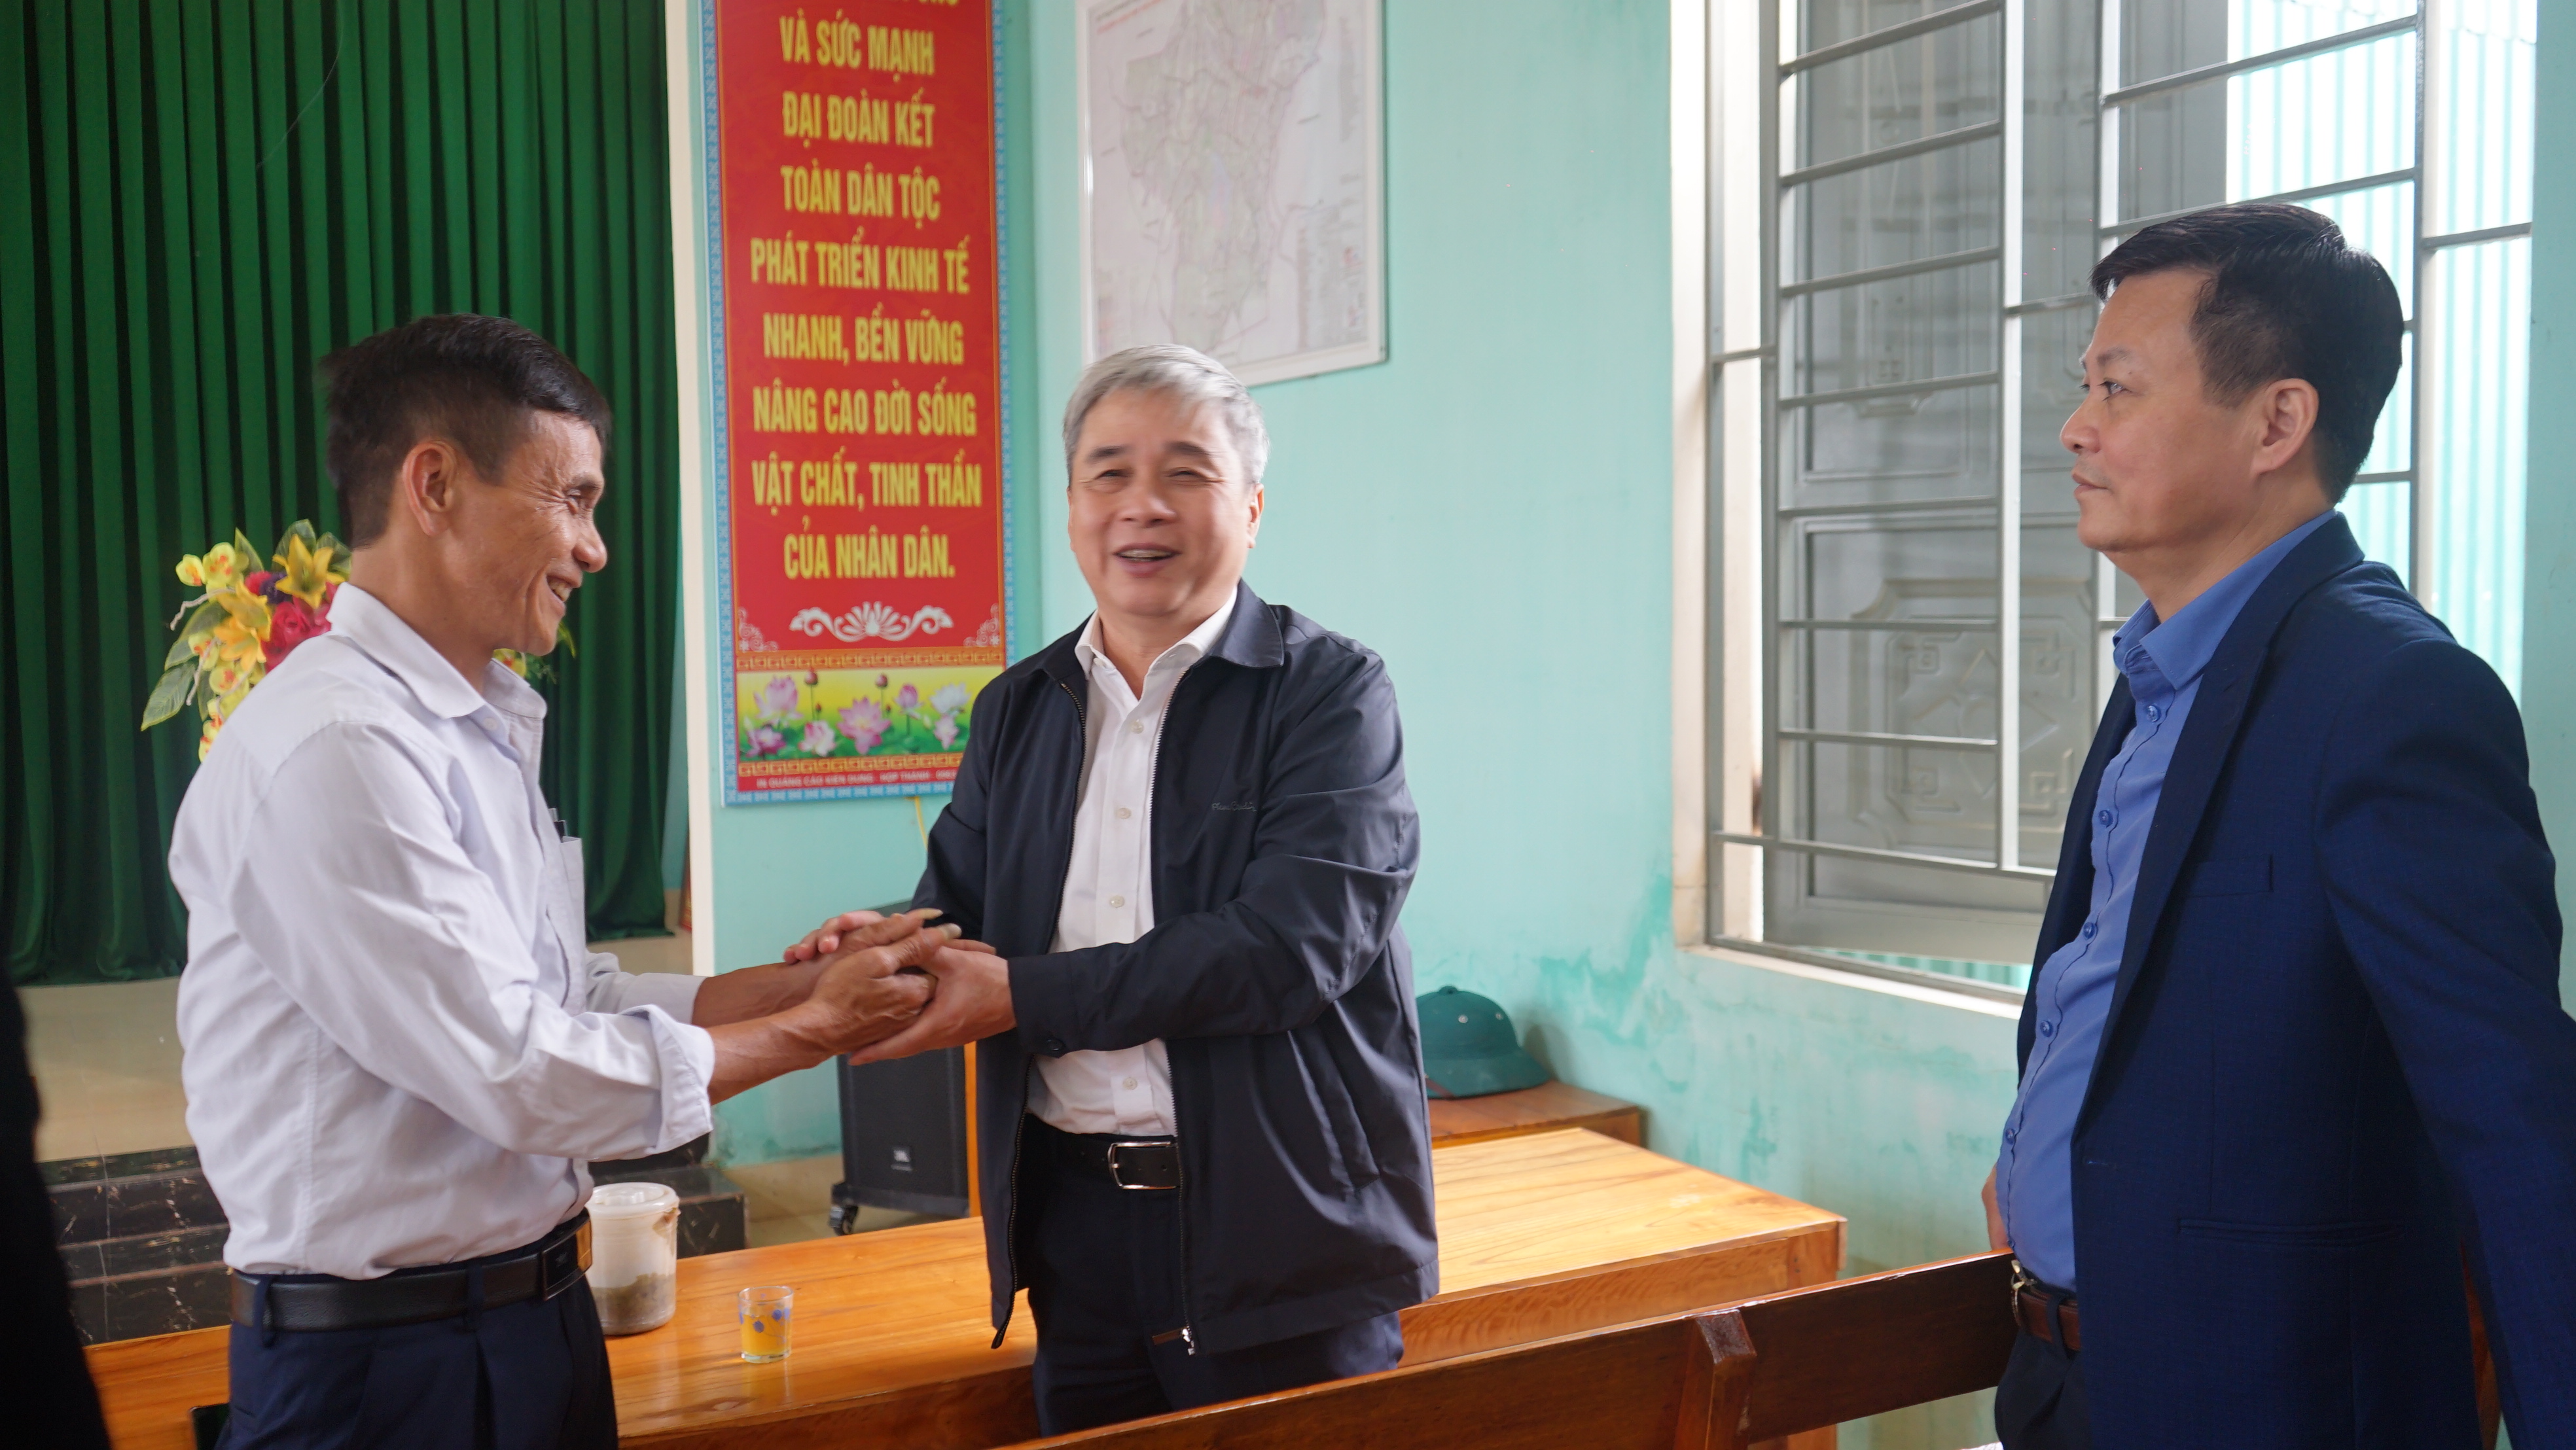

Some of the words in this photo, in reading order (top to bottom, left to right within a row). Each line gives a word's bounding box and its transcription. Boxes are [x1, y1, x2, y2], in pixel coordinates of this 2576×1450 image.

[779, 9, 810, 63] VÀ
[817, 10, 861, 68] SỨC
[868, 26, 934, 81] MẠNH
[782, 91, 821, 147] ĐẠI
[827, 90, 889, 143] ĐOÀN
[895, 89, 935, 147] KẾT
[781, 159, 841, 213] TOÀN
[847, 163, 893, 217] DÂN
[898, 167, 940, 228] TỘC
[751, 231, 809, 285] PHÁT
[815, 227, 880, 289] TRIỂN
[886, 246, 939, 292] KINH
[944, 237, 969, 294] TẾ
[763, 313, 850, 365] NHANH,
[905, 309, 963, 364] VỮNG
[753, 378, 818, 433] NÂNG
[824, 388, 869, 434] CAO
[874, 380, 912, 434] ĐỜI
[918, 378, 976, 436] SỐNG
[751, 451, 794, 516] VẬT
[800, 446, 864, 510] CHẤT,
[869, 462, 920, 506] TINH
[784, 516, 831, 579] CỦA
[836, 525, 898, 578] NHÂN
[903, 525, 955, 578] DÂN.
